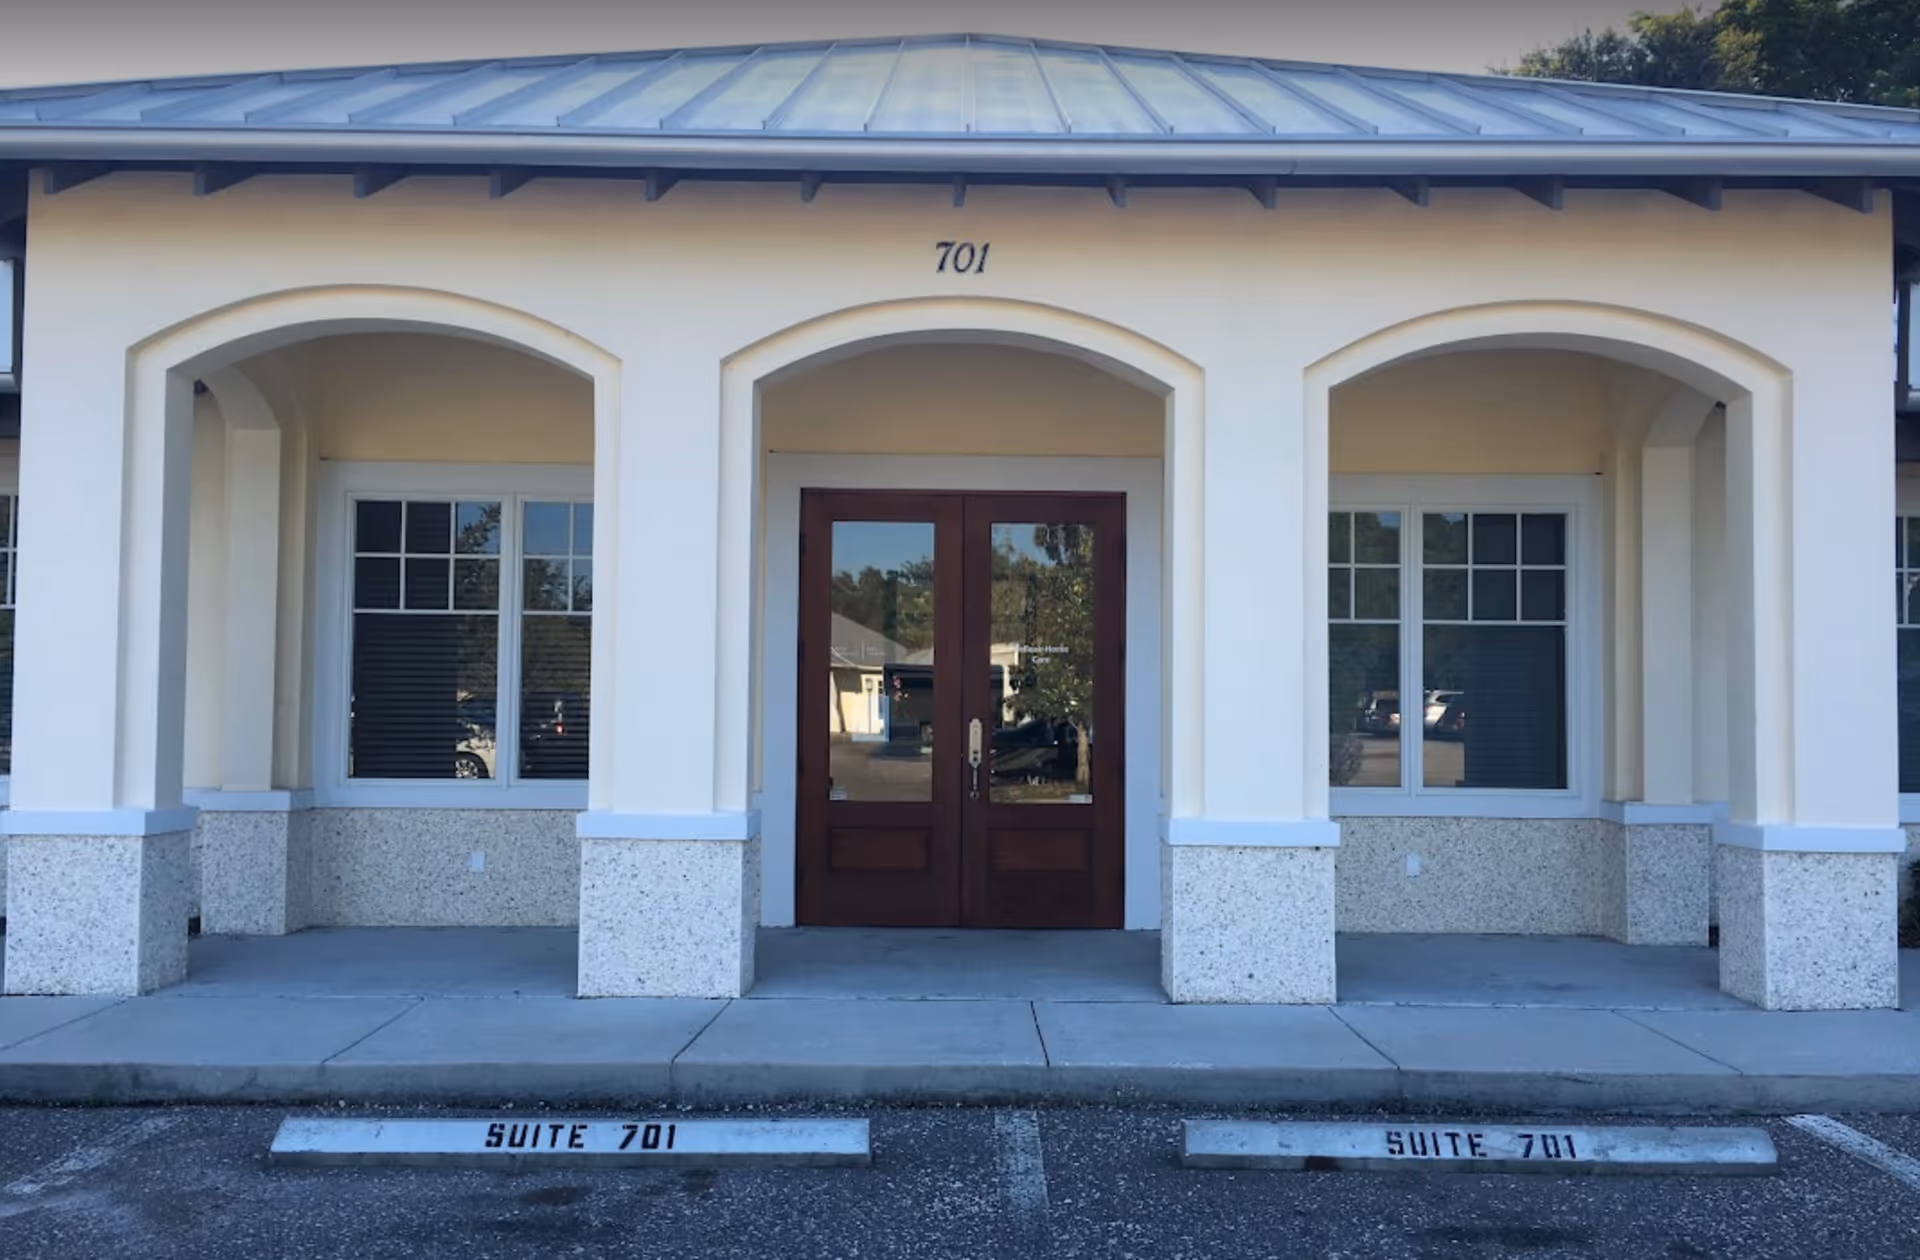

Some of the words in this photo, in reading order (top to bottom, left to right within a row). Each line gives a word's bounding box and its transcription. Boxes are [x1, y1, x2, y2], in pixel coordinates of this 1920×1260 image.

[936, 241, 990, 274] 701
[485, 1123, 588, 1149] SUITE
[618, 1124, 676, 1150] 701
[1385, 1131, 1488, 1158] SUITE
[1517, 1133, 1577, 1159] 701
